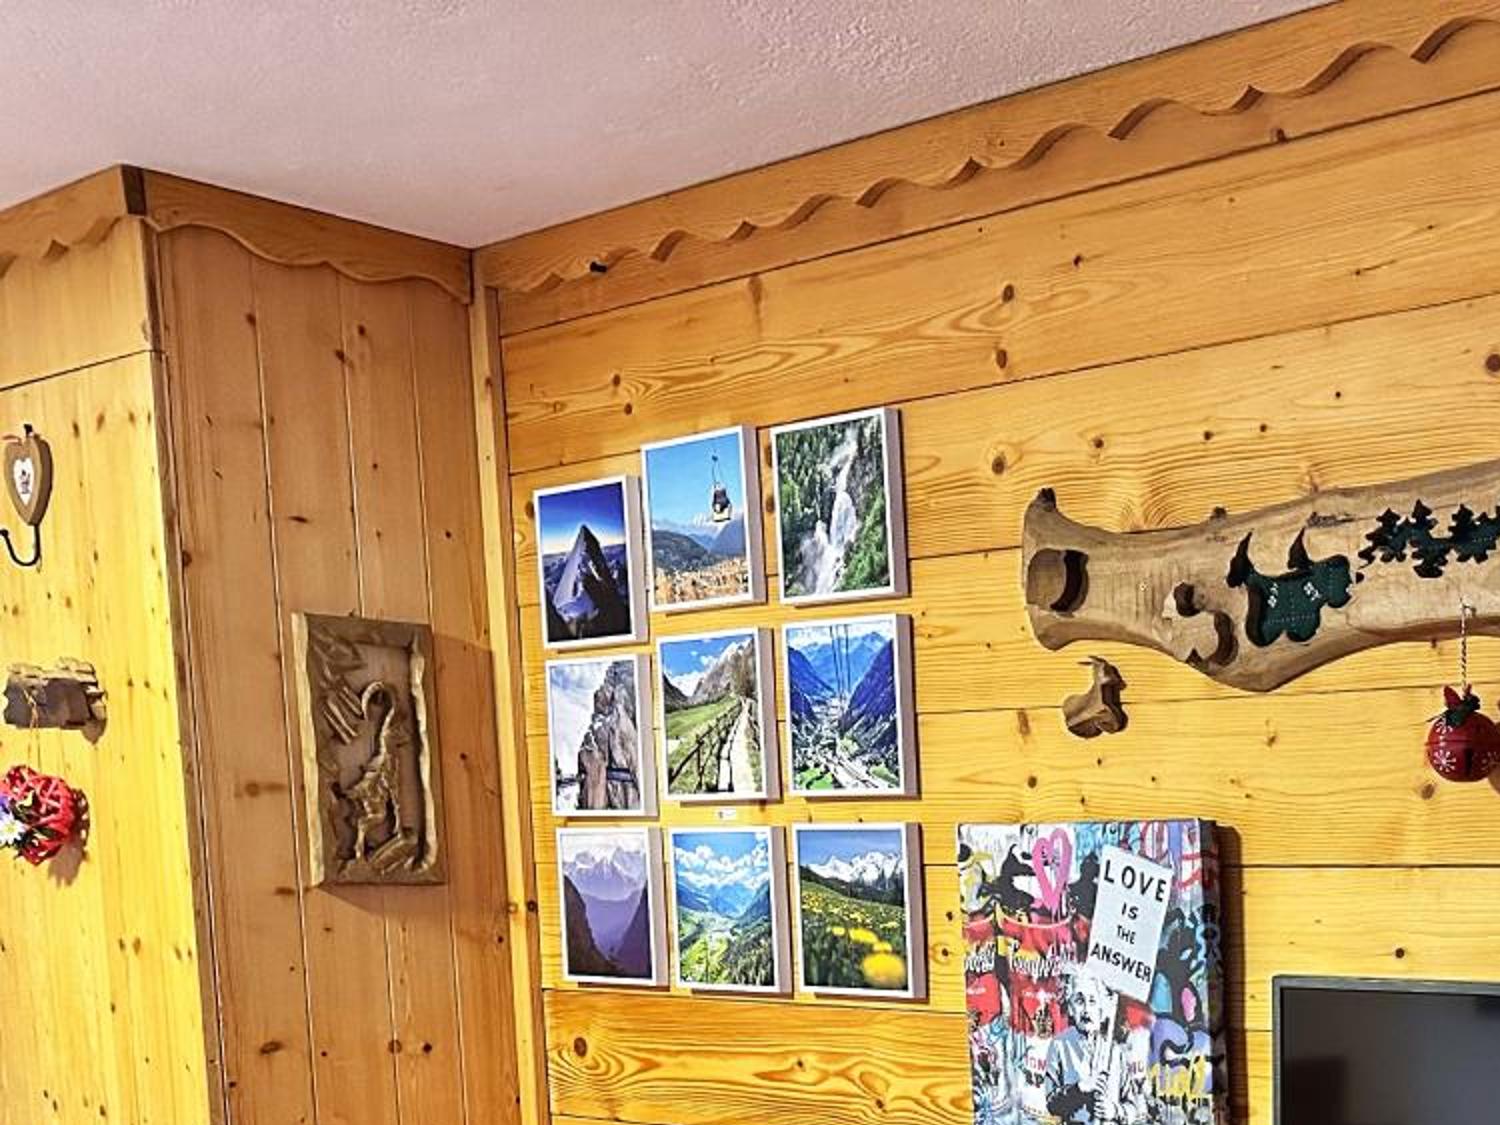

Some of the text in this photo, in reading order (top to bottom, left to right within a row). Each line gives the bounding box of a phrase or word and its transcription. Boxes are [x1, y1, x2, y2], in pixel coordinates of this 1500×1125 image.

[1103, 859, 1167, 903] LOVE
[1121, 901, 1139, 921] IS
[1116, 925, 1137, 945] THE
[1090, 944, 1151, 982] ANSWER
